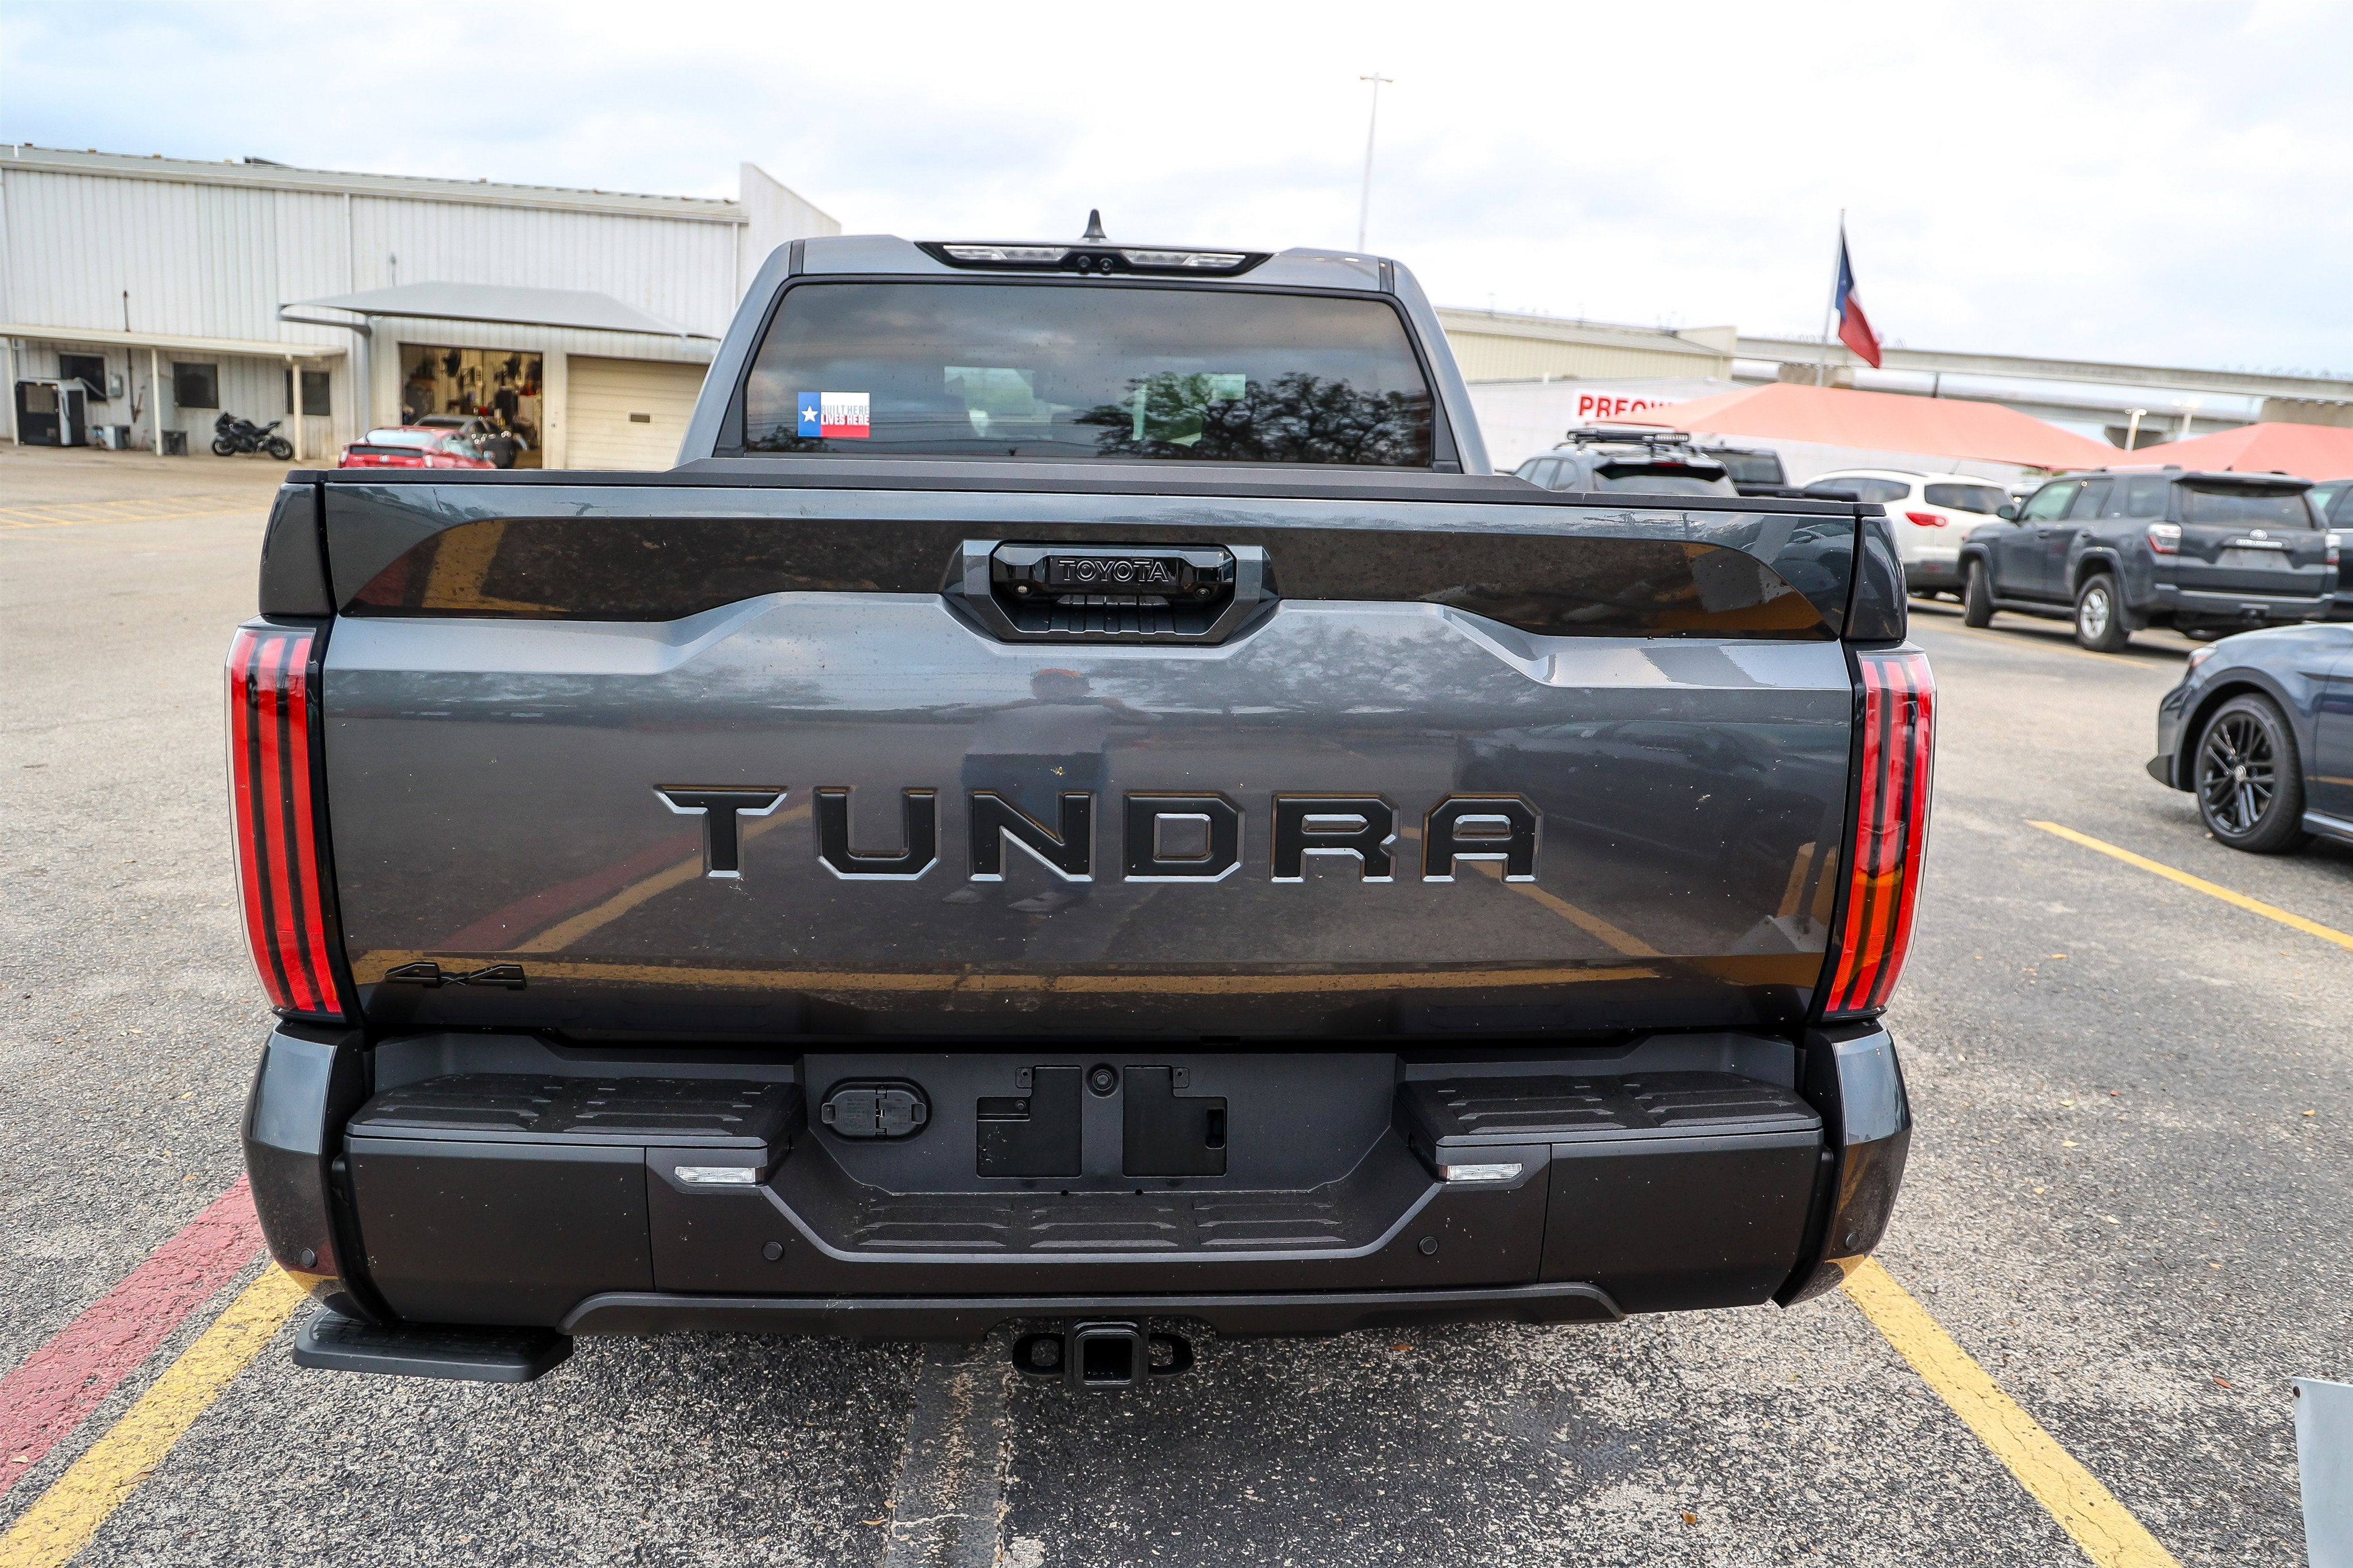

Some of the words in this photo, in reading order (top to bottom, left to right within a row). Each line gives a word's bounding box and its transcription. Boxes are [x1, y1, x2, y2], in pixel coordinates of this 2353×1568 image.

[821, 405, 845, 414] BUILT
[847, 405, 870, 415] HERE
[1579, 393, 1672, 418] PRE
[821, 414, 846, 425] LIVES
[847, 414, 870, 425] HERE
[1058, 559, 1169, 582] TOYOTA
[653, 785, 1544, 883] TUNDRA
